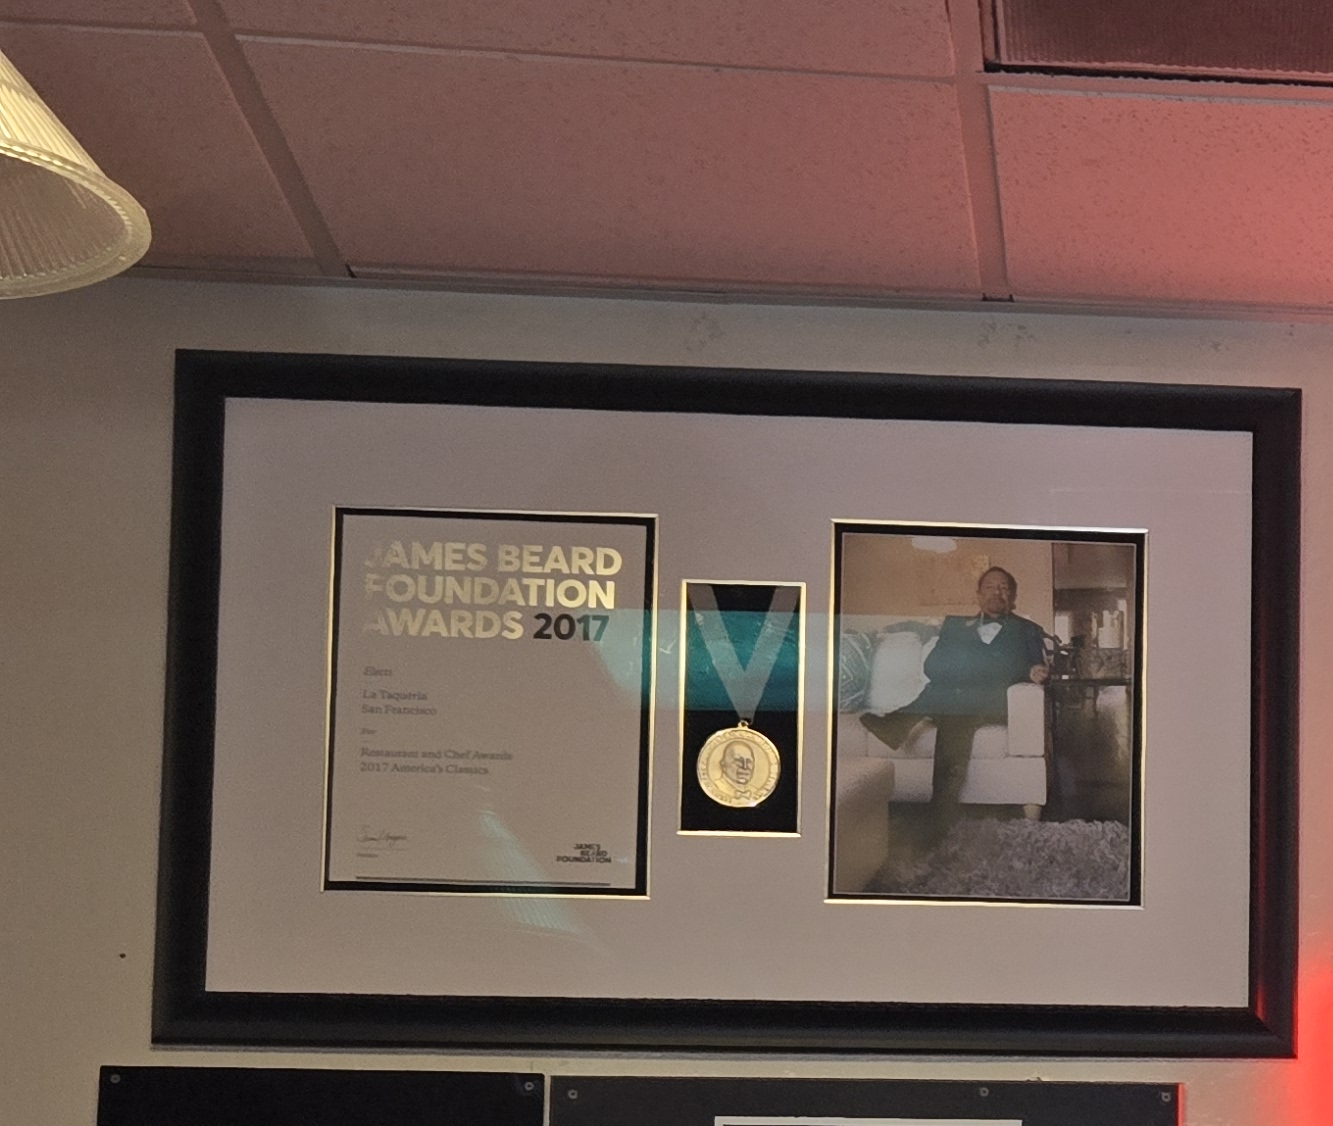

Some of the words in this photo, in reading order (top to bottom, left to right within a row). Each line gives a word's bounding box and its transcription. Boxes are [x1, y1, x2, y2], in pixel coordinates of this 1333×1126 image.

[497, 544, 623, 576] BEARD
[363, 572, 616, 610] FOUNDATION
[362, 607, 525, 640] AWARDS
[533, 612, 610, 642] 2017
